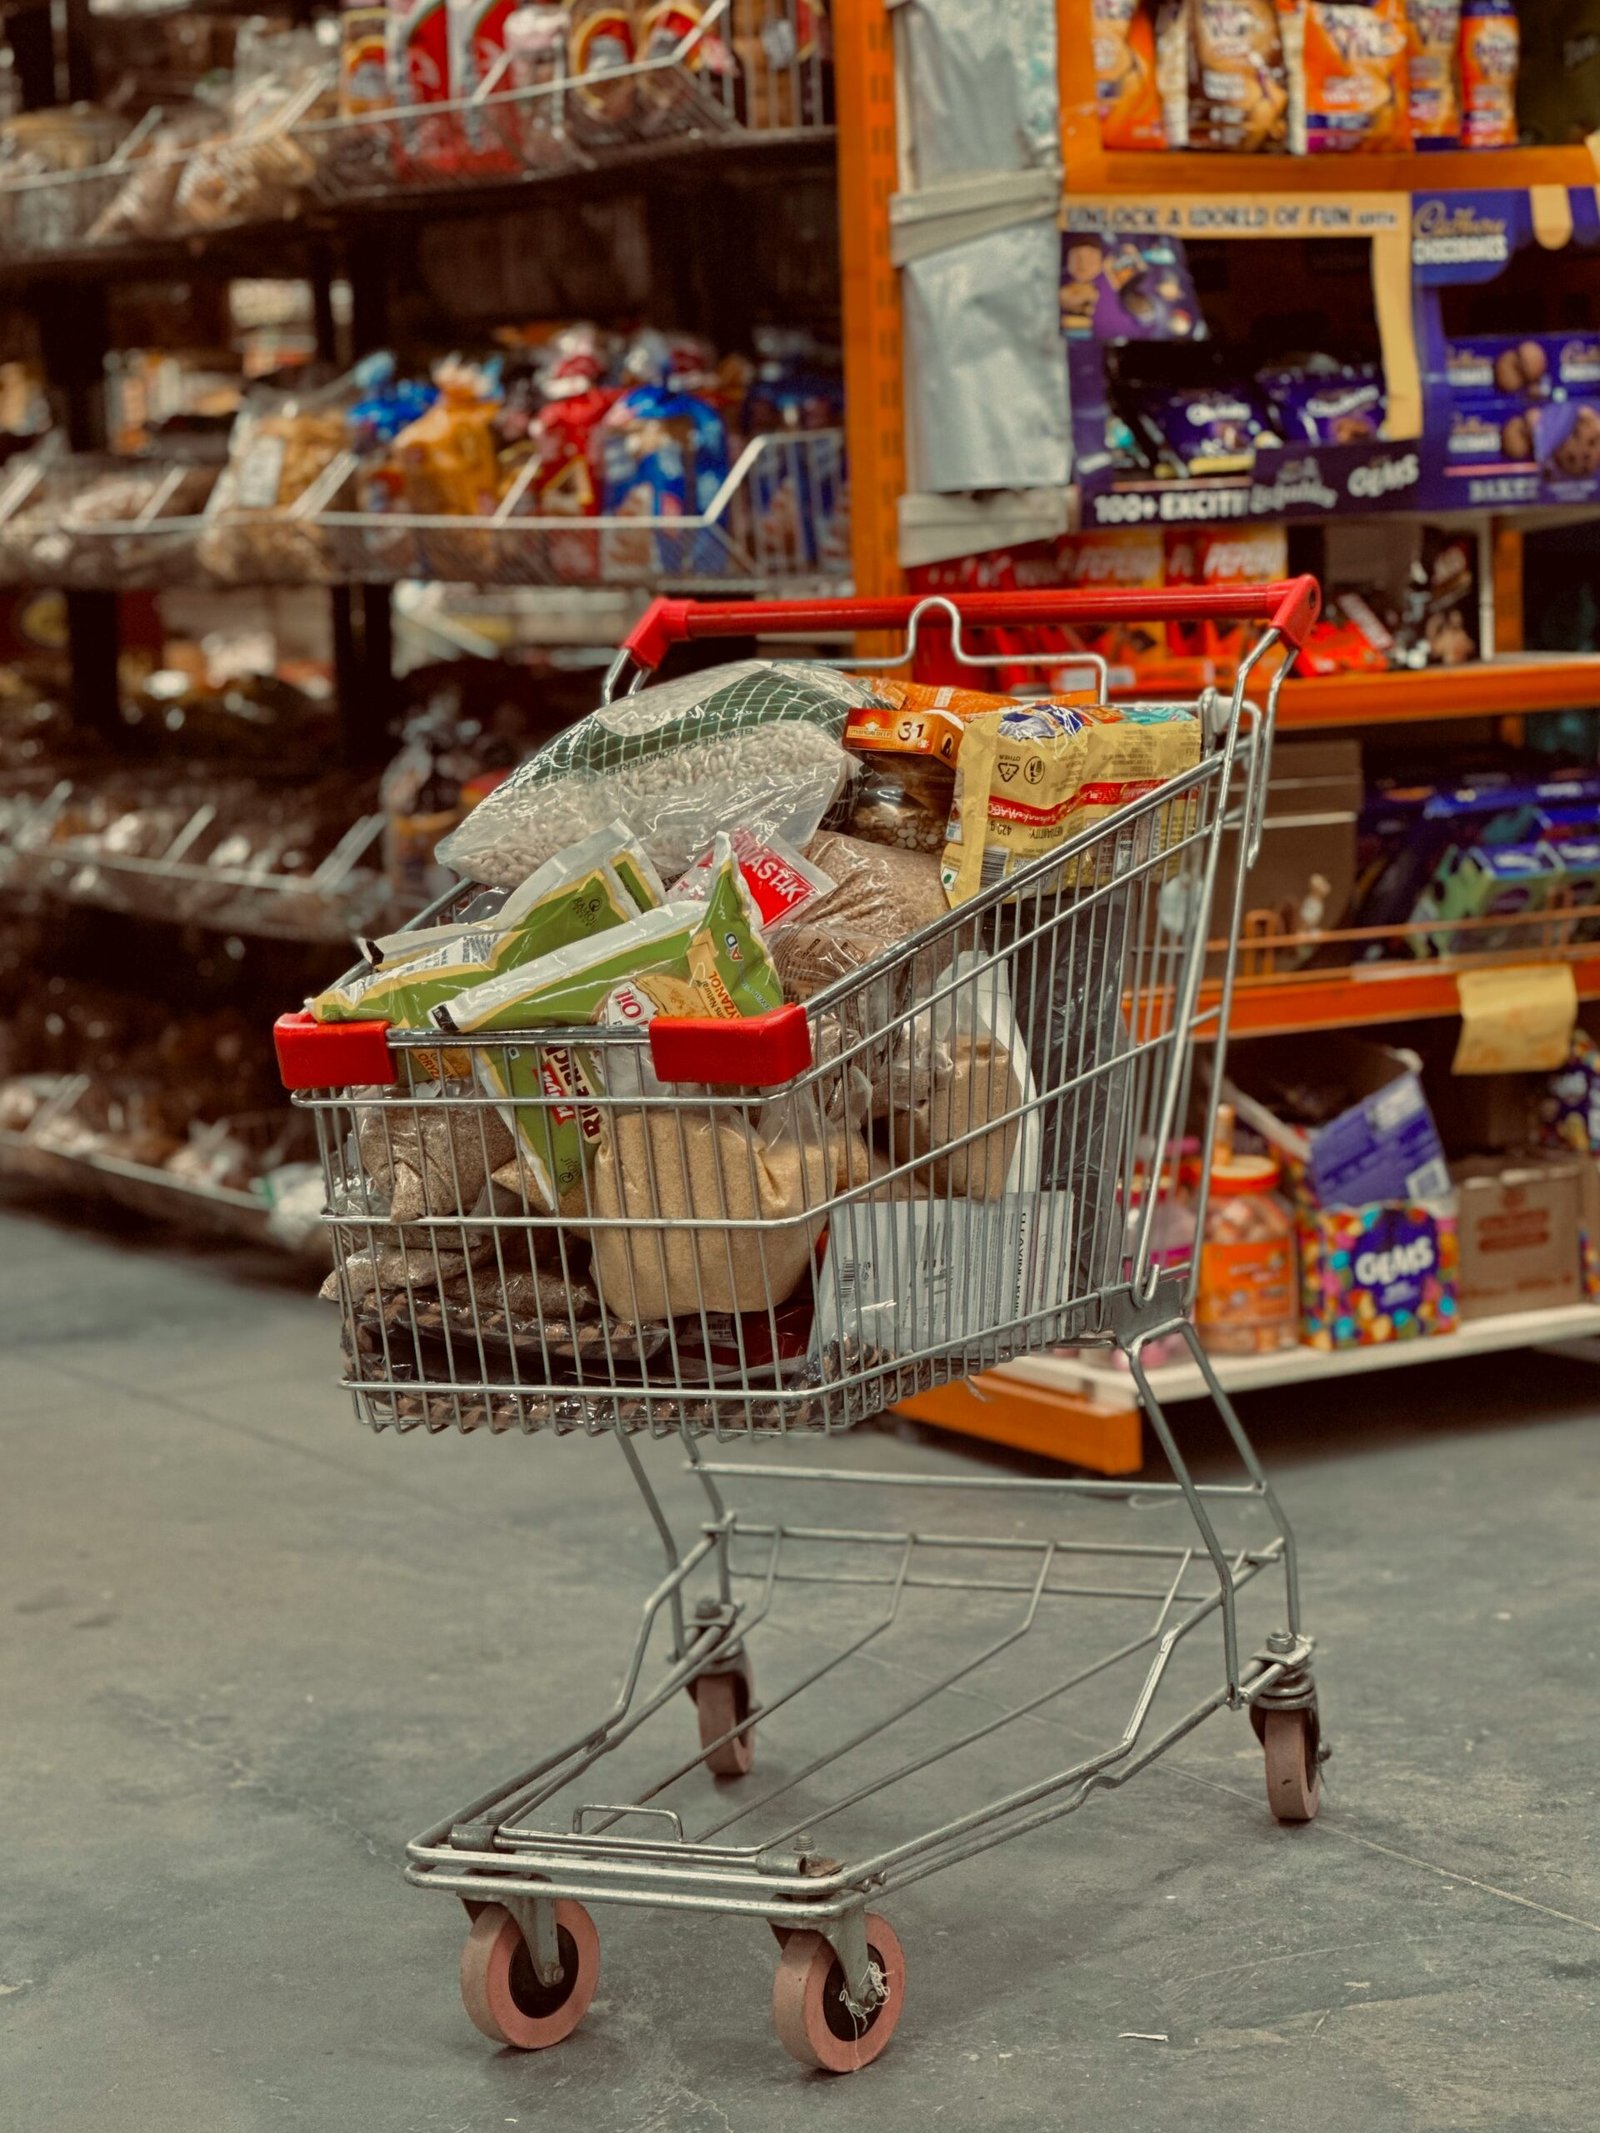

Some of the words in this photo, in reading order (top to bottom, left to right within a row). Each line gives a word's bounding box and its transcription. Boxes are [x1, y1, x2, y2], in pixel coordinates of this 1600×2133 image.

[1068, 205, 1158, 228] UNLOCK
[1168, 207, 1180, 226] A
[1189, 205, 1268, 228] WORLD
[1274, 205, 1301, 227] OF
[1308, 204, 1351, 226] FUN
[1095, 494, 1157, 523] 100+
[682, 740, 701, 751] OF
[701, 727, 754, 746] BEWARE
[708, 971, 741, 1018] YZANOL
[1355, 1235, 1435, 1286] GEMS
